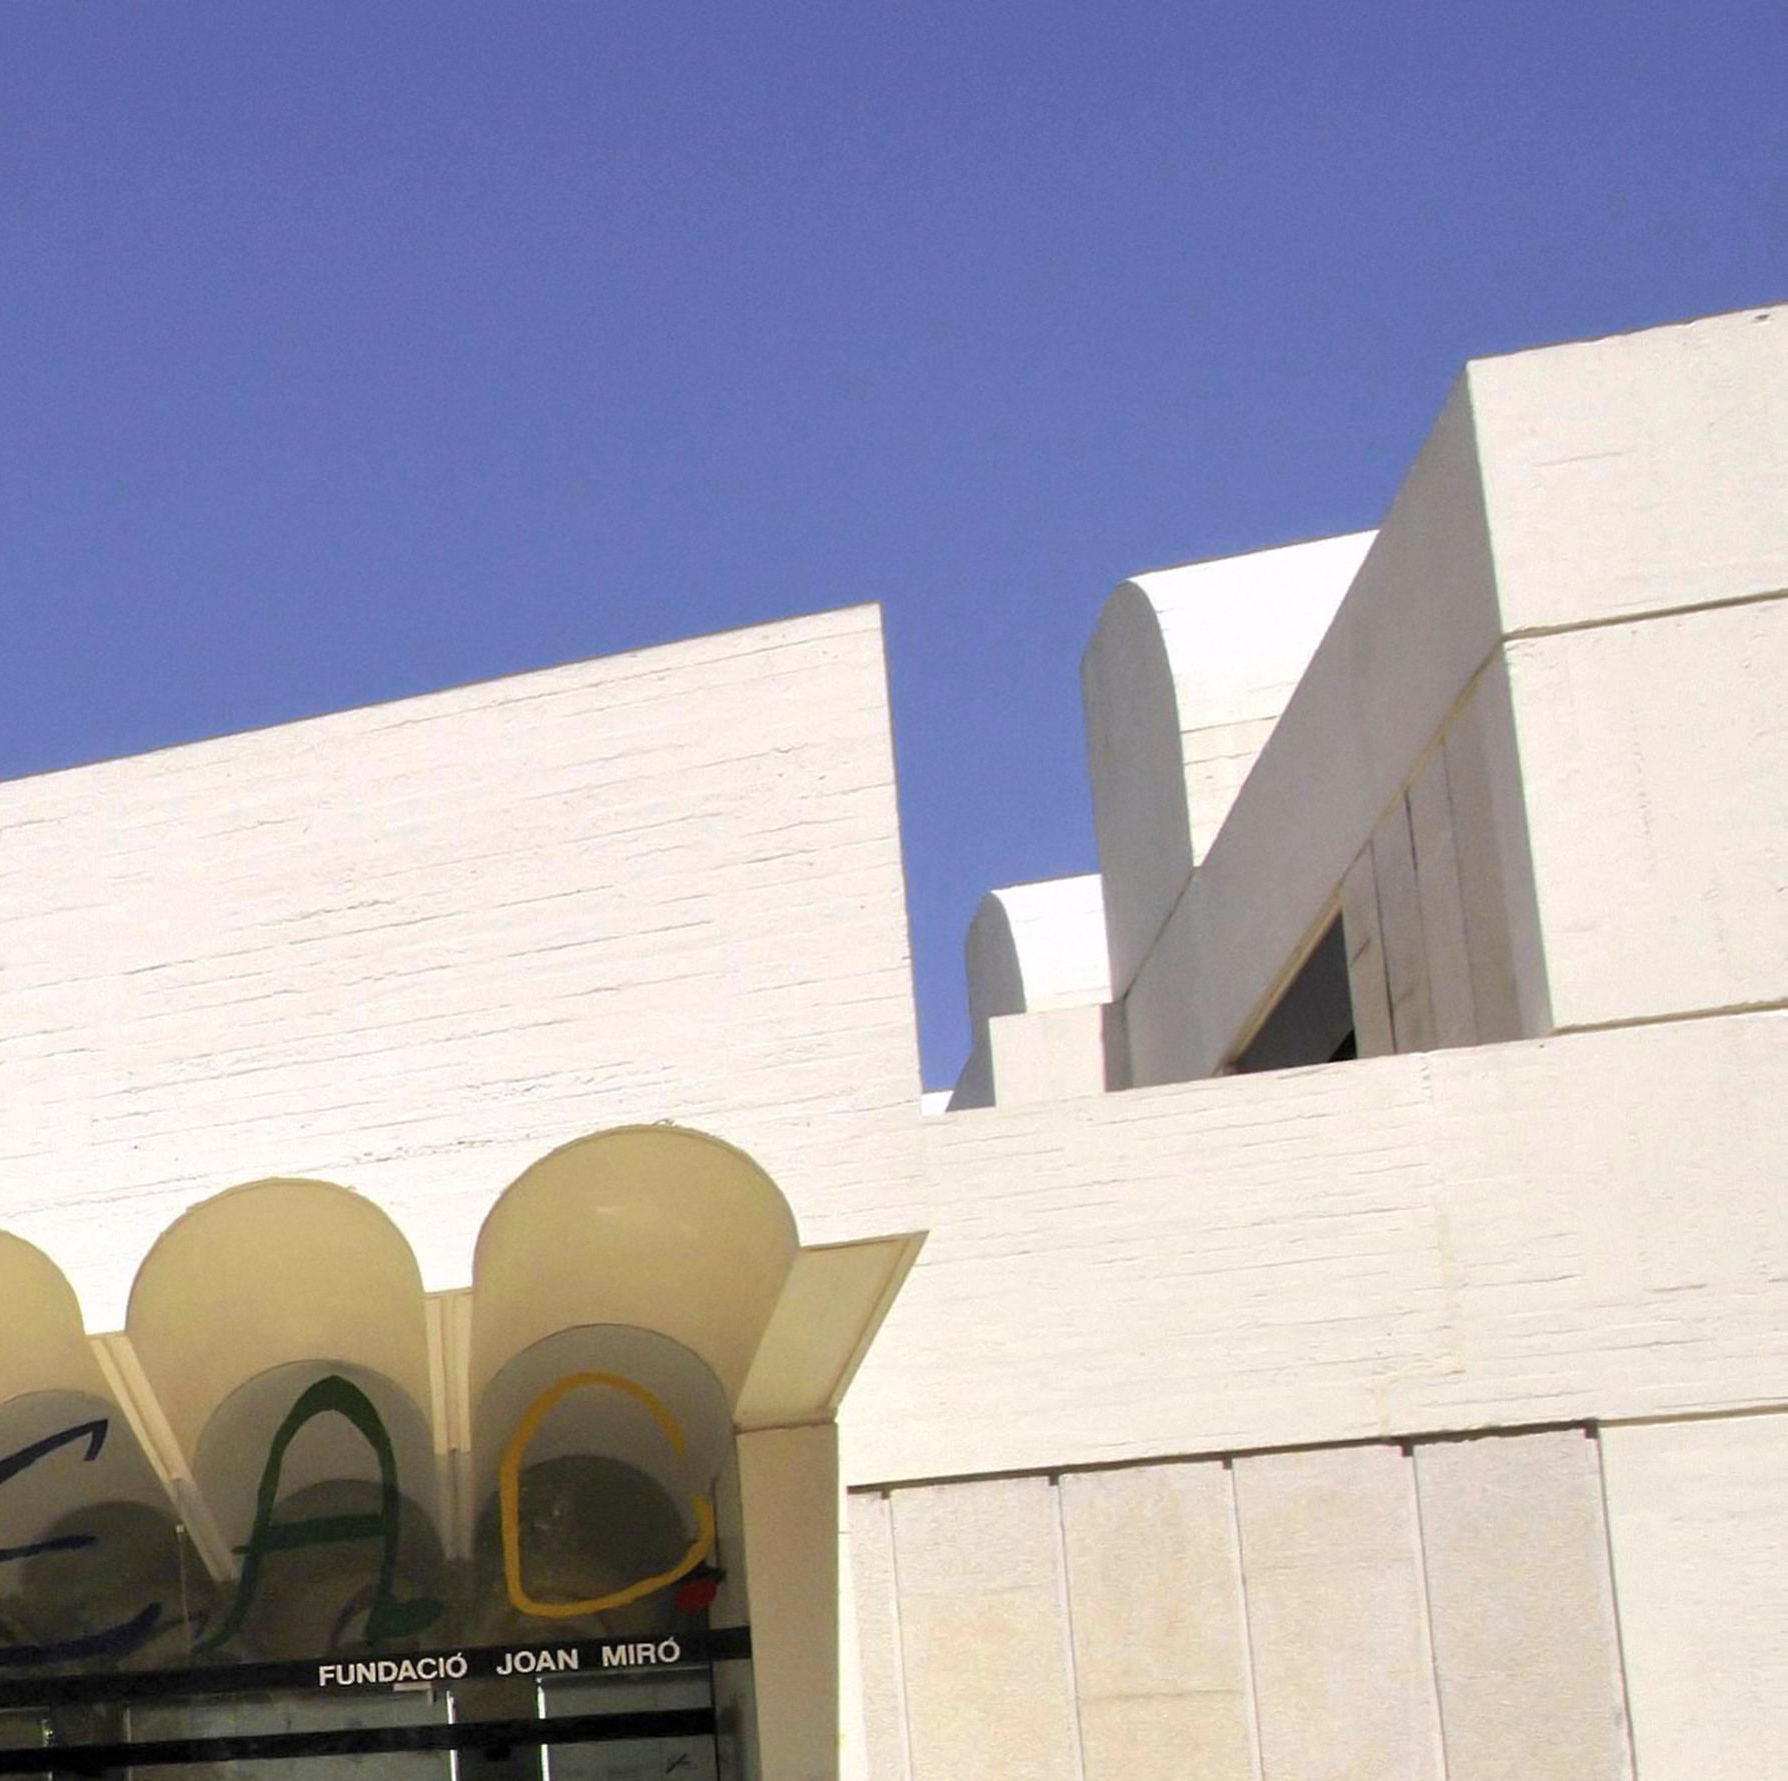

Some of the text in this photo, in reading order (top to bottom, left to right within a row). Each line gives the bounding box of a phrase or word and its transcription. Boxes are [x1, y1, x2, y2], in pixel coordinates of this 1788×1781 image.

[319, 1637, 681, 1686] FUNDACIÓ JOAN MIRÓ
